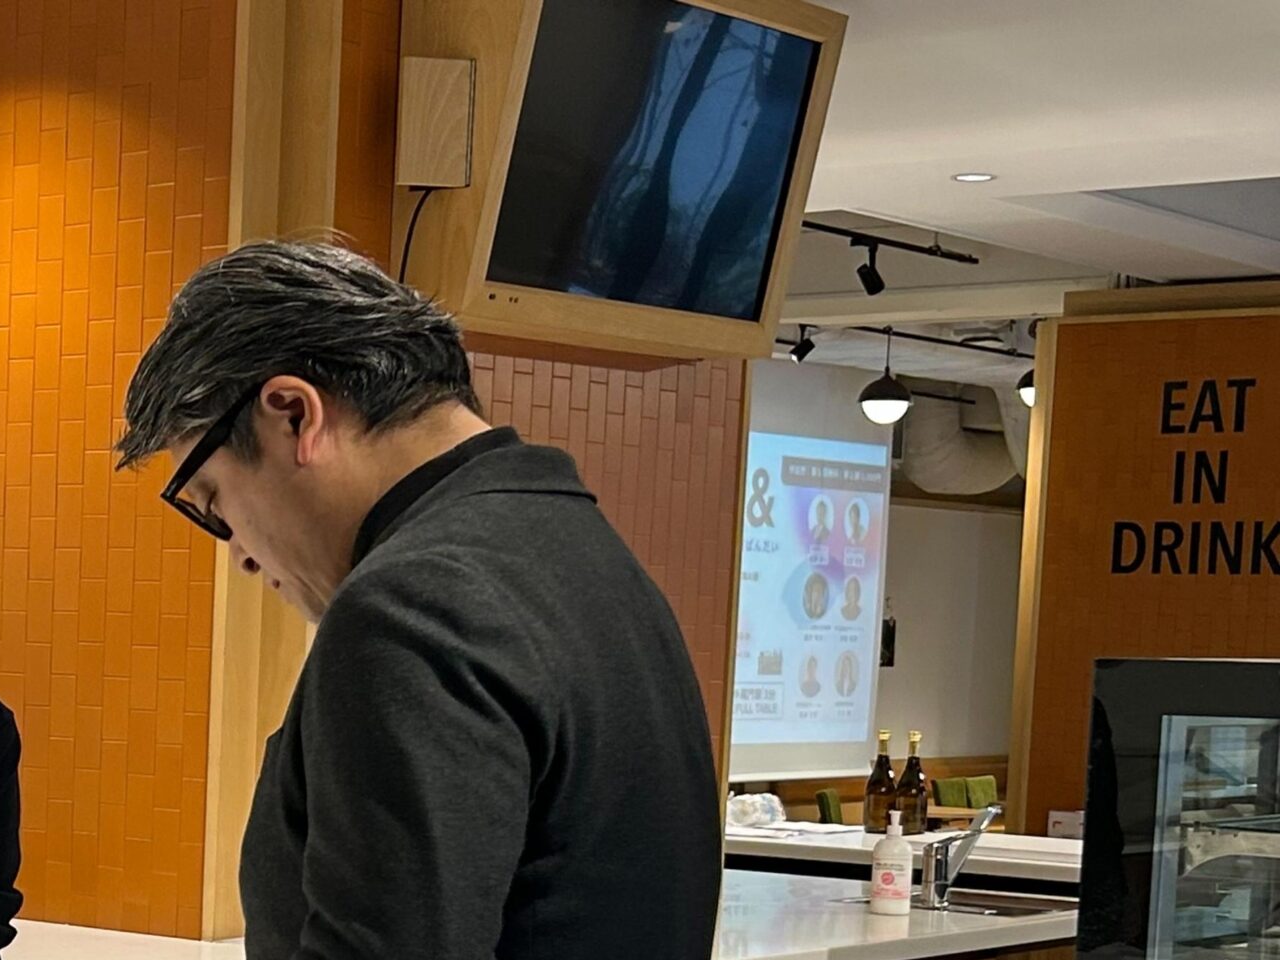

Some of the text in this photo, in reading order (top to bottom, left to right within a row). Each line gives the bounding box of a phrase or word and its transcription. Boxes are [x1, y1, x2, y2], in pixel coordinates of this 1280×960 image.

[1161, 378, 1257, 435] EAT
[746, 467, 775, 528] &
[1173, 450, 1229, 504] IN
[1111, 521, 1280, 576] DRINK
